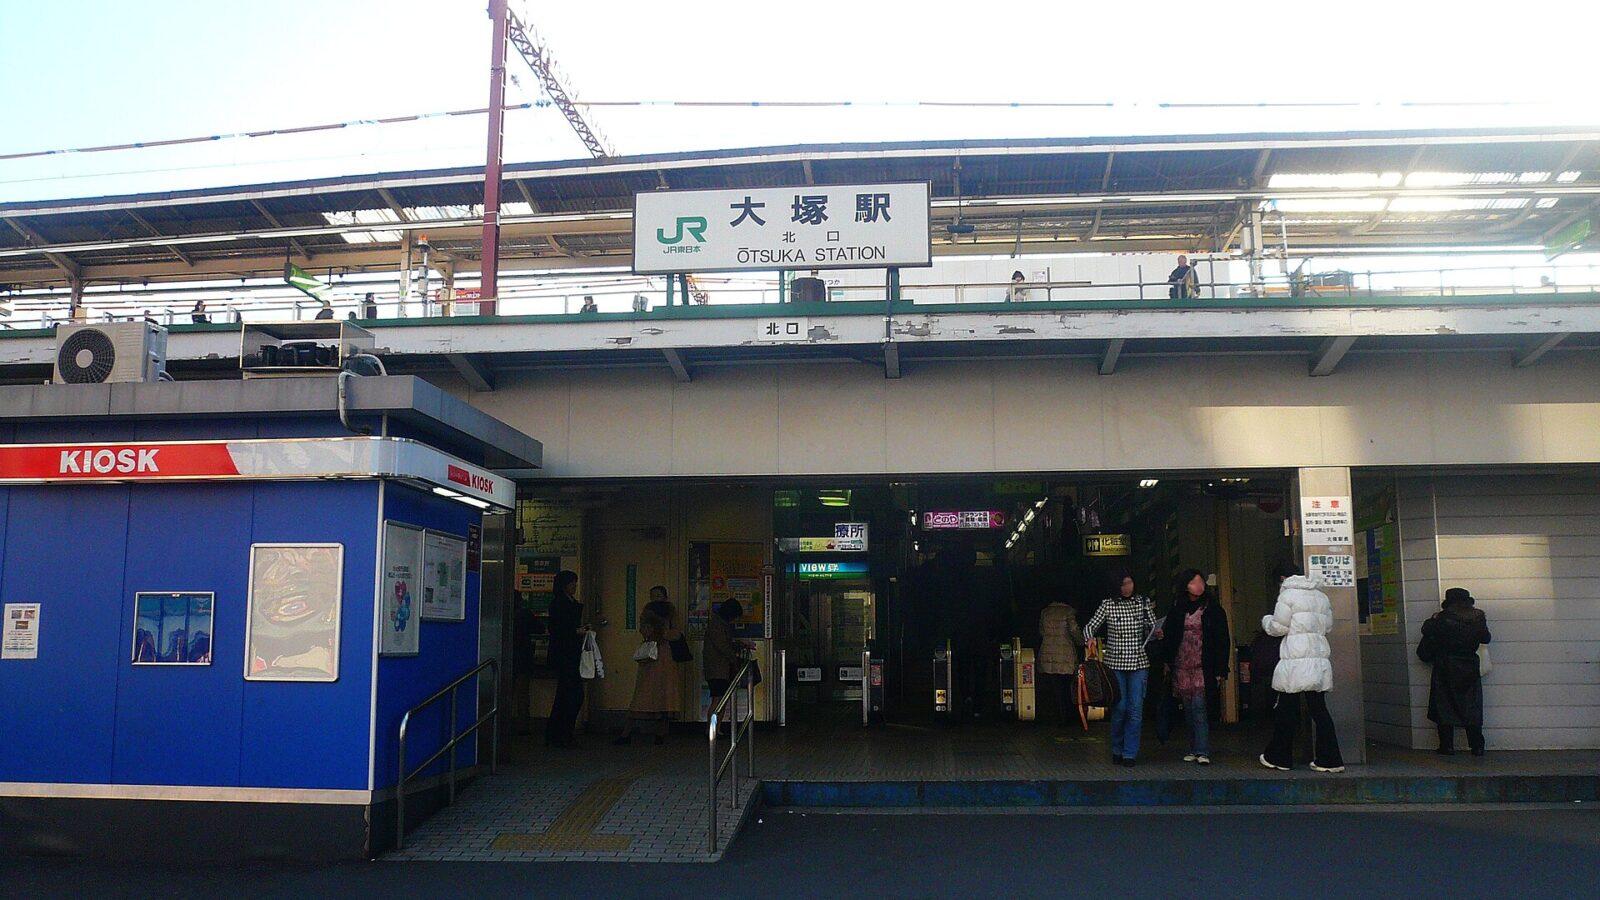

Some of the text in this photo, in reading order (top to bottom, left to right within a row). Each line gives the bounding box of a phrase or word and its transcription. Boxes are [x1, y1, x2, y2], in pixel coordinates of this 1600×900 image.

[729, 193, 892, 228] 大塚駅
[656, 216, 708, 245] JR
[781, 230, 840, 244] 北口
[663, 245, 702, 254] JR東日本
[815, 245, 886, 262] STATION
[765, 321, 800, 336] 北口
[58, 447, 160, 474] KIOSK
[471, 473, 495, 495] KIOSK
[801, 562, 827, 573] VIEW
